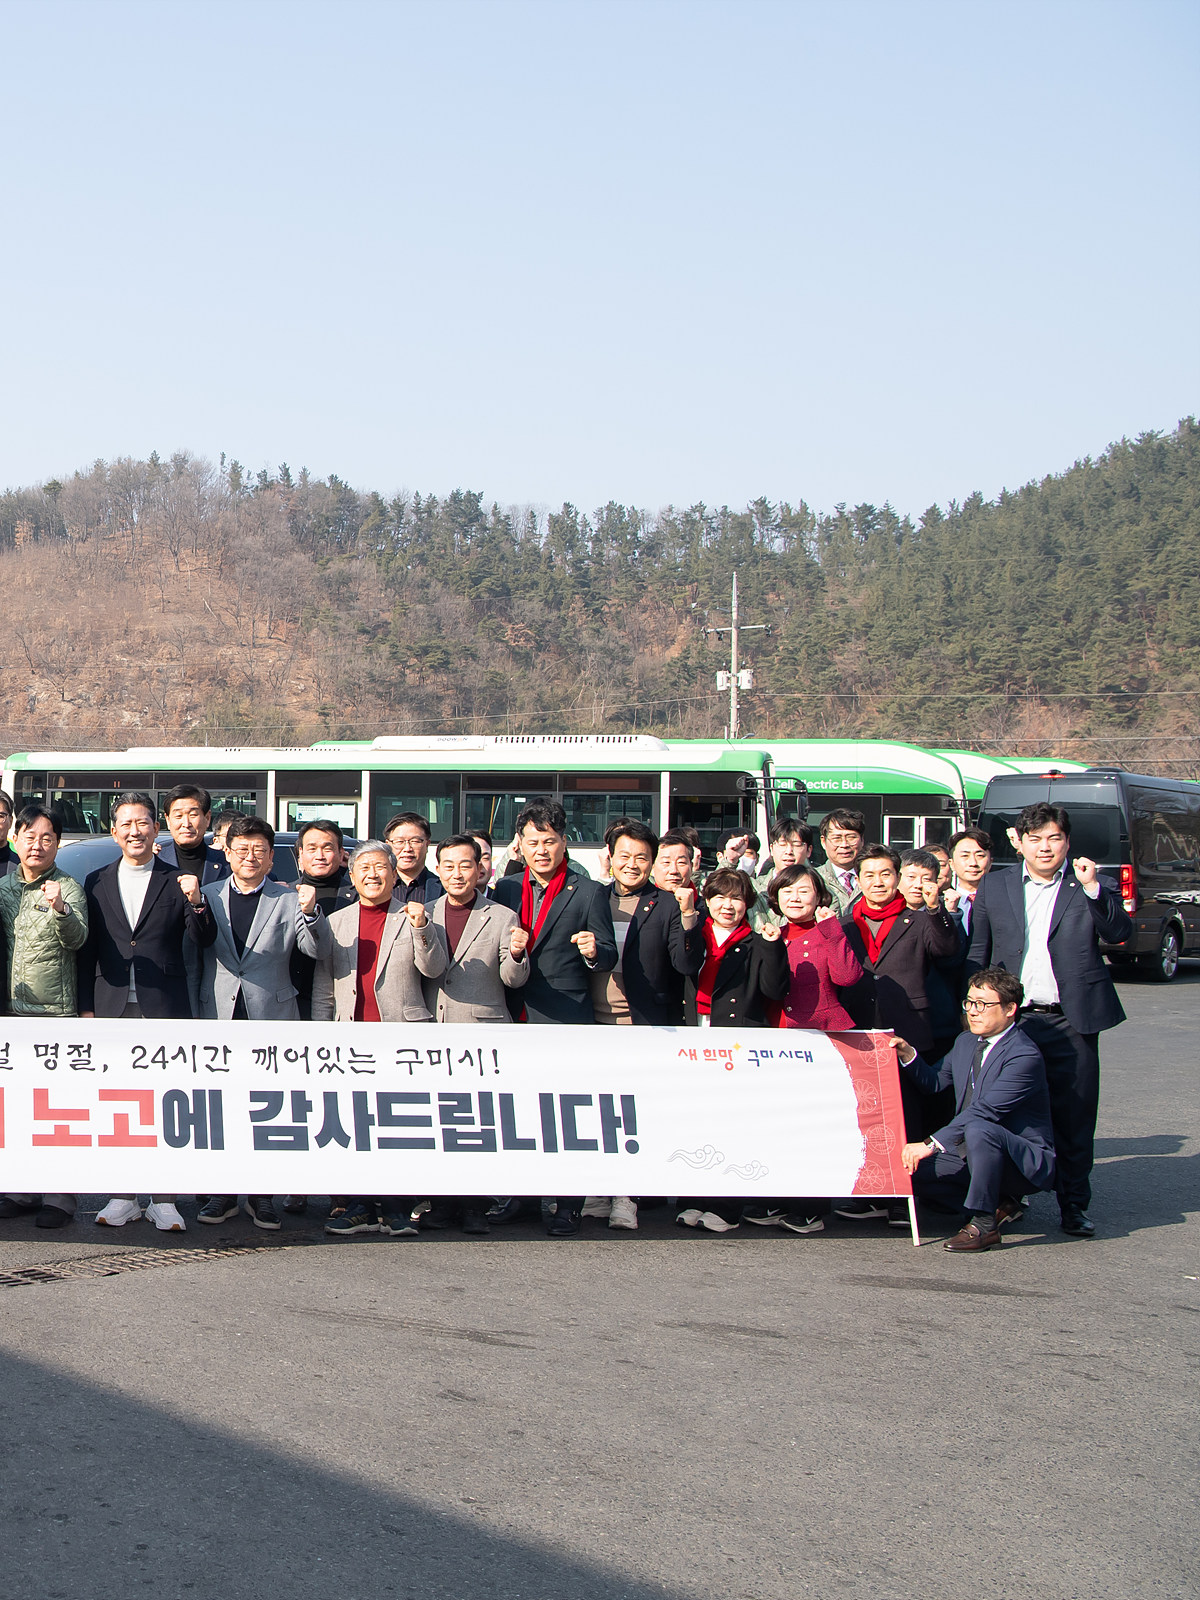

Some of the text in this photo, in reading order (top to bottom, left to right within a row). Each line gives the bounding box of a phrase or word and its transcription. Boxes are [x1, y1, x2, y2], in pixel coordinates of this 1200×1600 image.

[799, 779, 839, 790] ectric
[841, 779, 864, 790] Bus
[33, 1043, 109, 1073] 명절,
[131, 1044, 232, 1073] 24시간
[251, 1045, 377, 1075] 깨어있는
[395, 1047, 500, 1076] 구미시!
[31, 1088, 225, 1151] 노고에
[248, 1090, 640, 1155] 감사드립니다!
